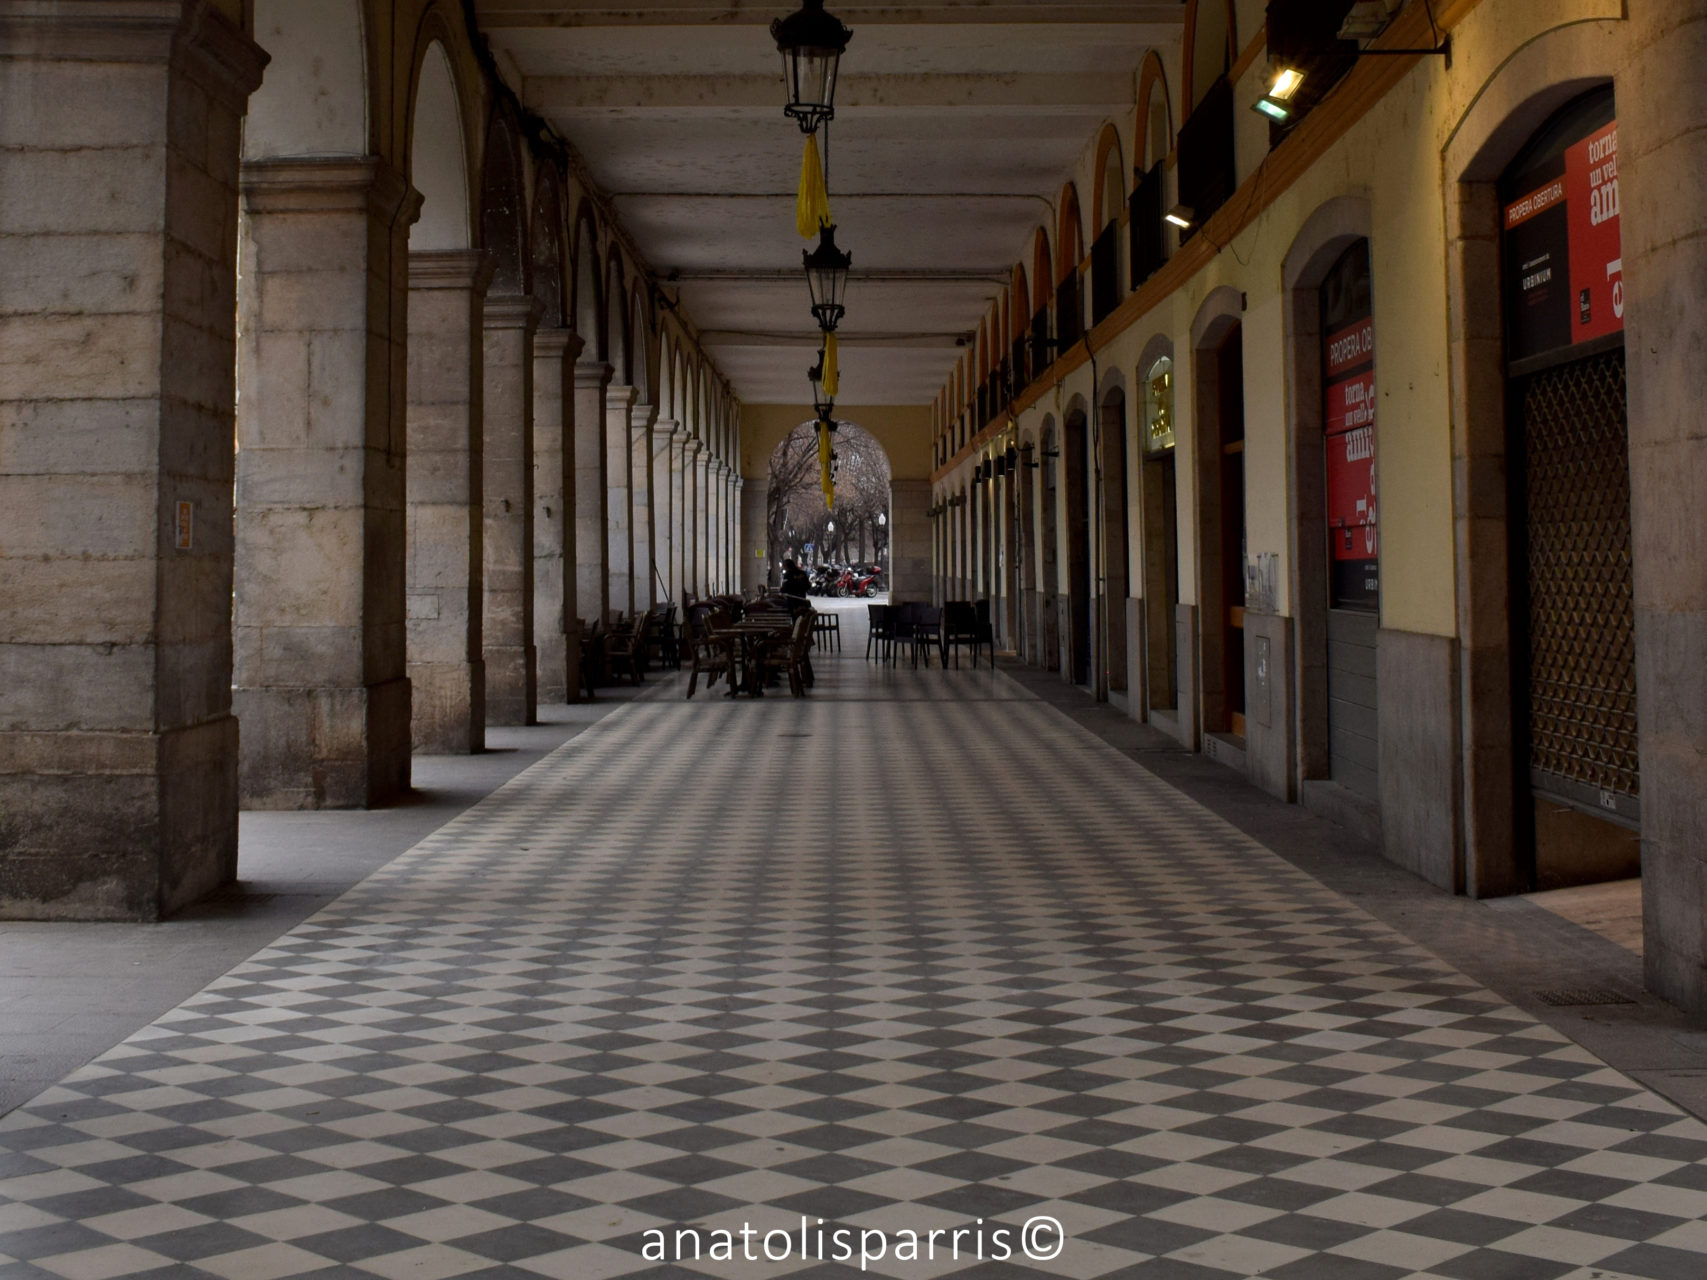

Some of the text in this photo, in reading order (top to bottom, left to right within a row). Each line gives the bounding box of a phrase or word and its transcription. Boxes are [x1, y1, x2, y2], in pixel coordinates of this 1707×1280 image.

[1508, 183, 1562, 223] PROPERA OBERTURA
[1330, 332, 1360, 366] PROPERA
